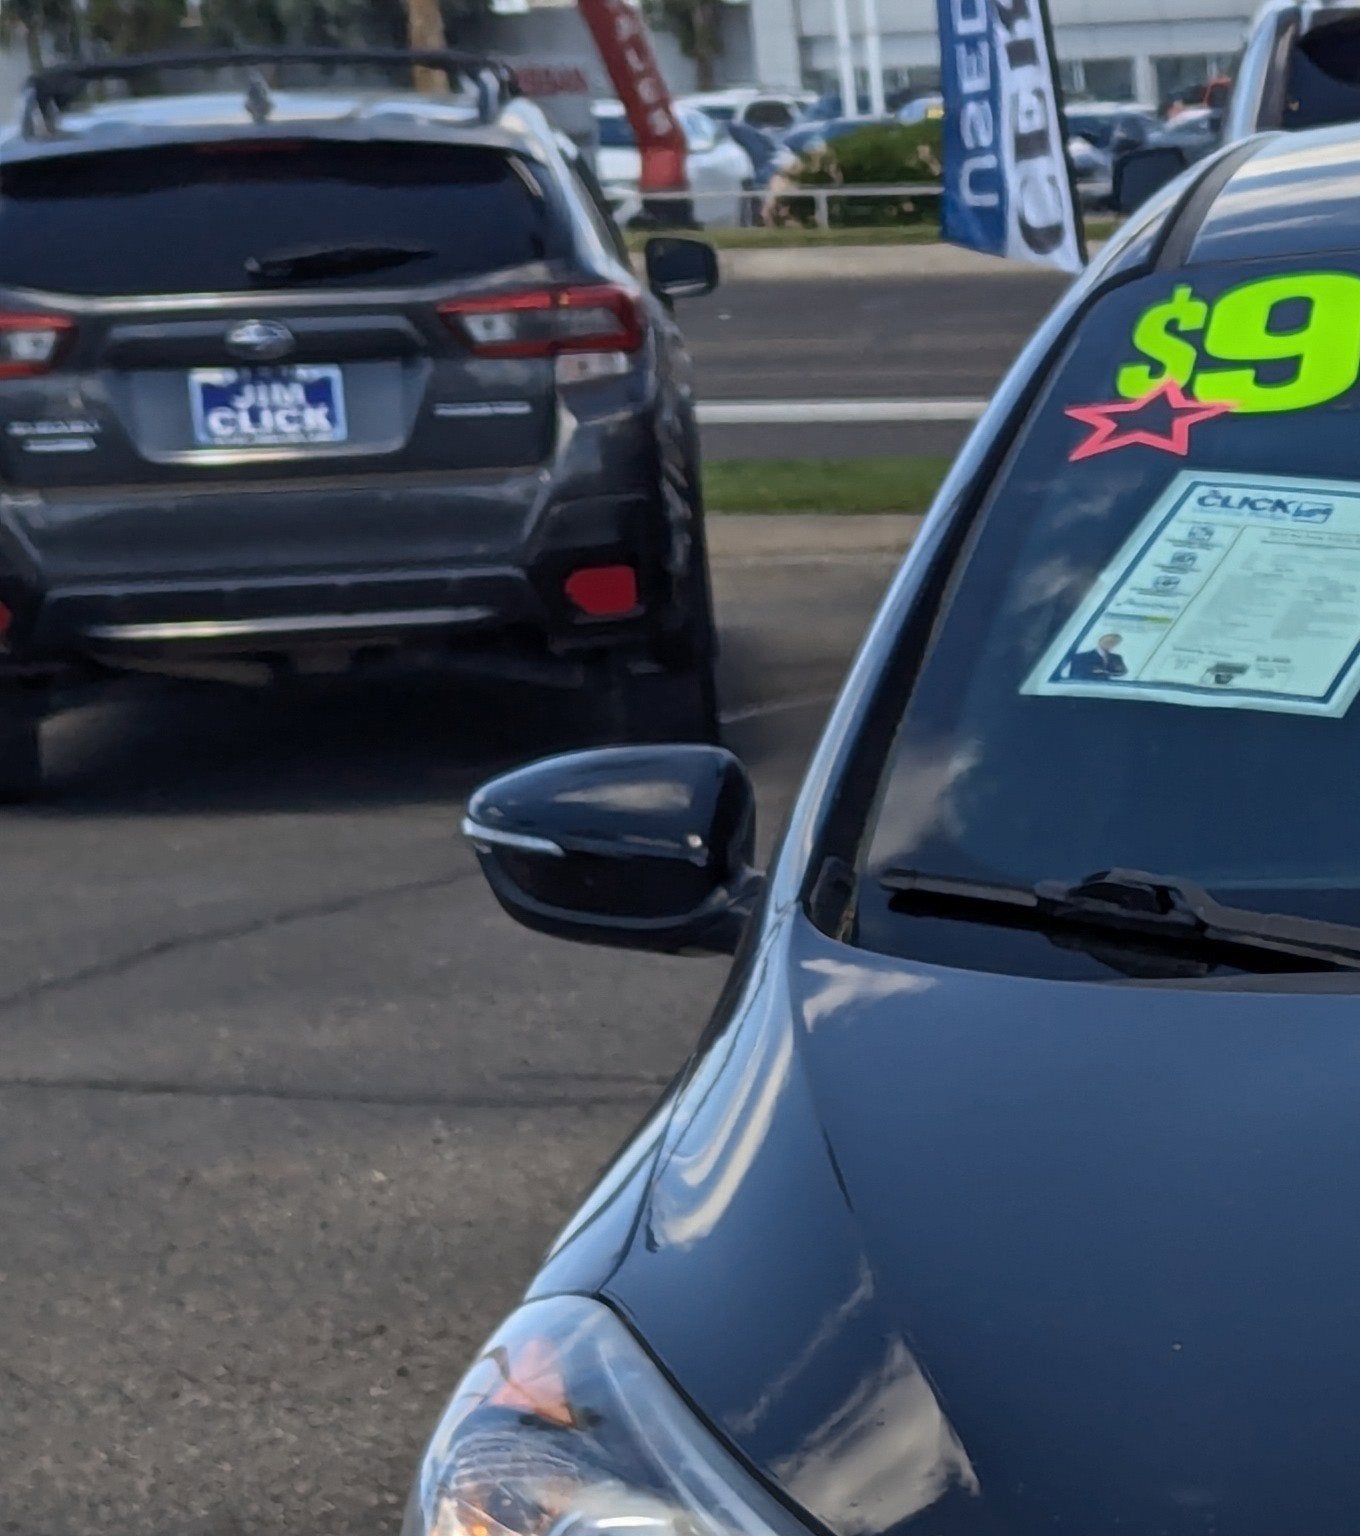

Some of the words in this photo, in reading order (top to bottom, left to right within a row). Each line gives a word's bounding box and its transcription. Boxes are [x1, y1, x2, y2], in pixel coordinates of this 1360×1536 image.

[229, 381, 308, 409] JIM
[207, 403, 333, 436] CLICK
[1197, 494, 1292, 514] CLICK
